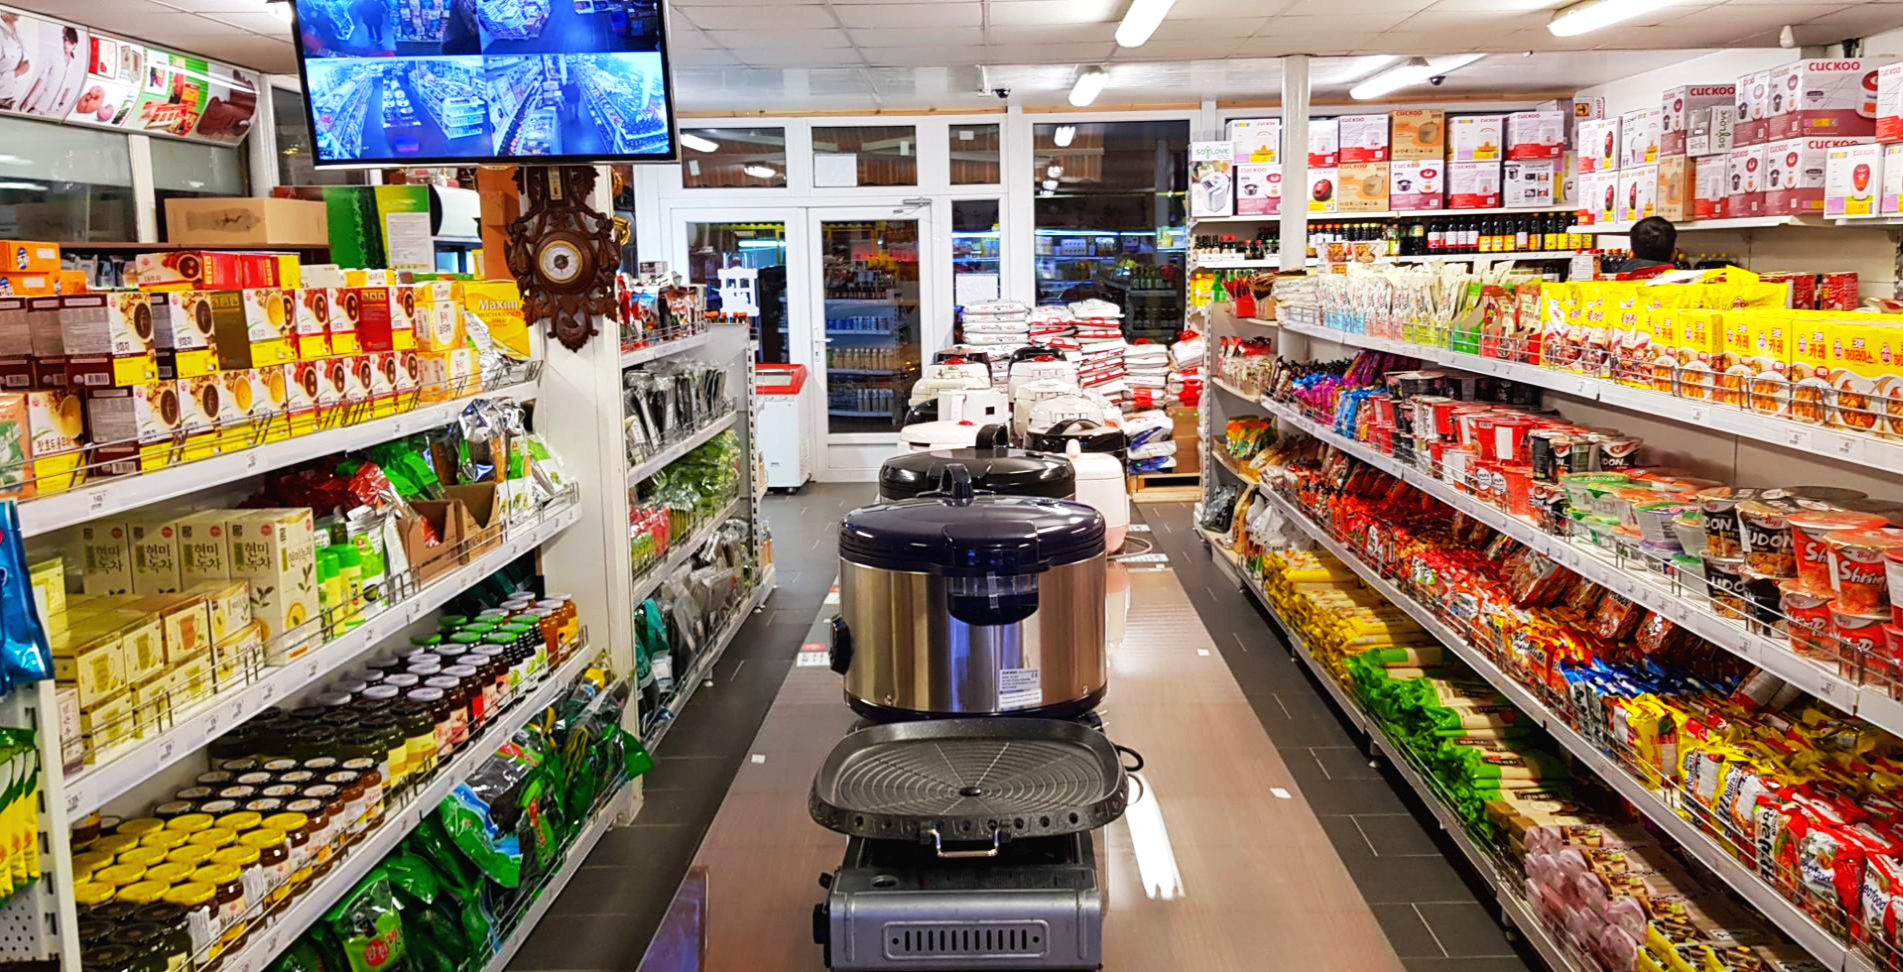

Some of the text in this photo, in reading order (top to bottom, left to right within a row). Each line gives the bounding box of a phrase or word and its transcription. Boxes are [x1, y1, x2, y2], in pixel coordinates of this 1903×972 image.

[1808, 61, 1860, 71] CUCKOO
[1878, 66, 1901, 77] CUCKOO
[1690, 86, 1735, 96] CUCKOO
[1195, 145, 1230, 160] SOYLOVE
[479, 300, 518, 310] Maxim
[1735, 334, 1750, 350] 카레
[1768, 338, 1784, 355] 카레
[1809, 343, 1826, 360] 카레
[1704, 517, 1733, 531] DON
[146, 543, 171, 559] 현미
[194, 542, 219, 558] 현미
[245, 541, 270, 557] 현미
[1711, 575, 1746, 593] UDO
